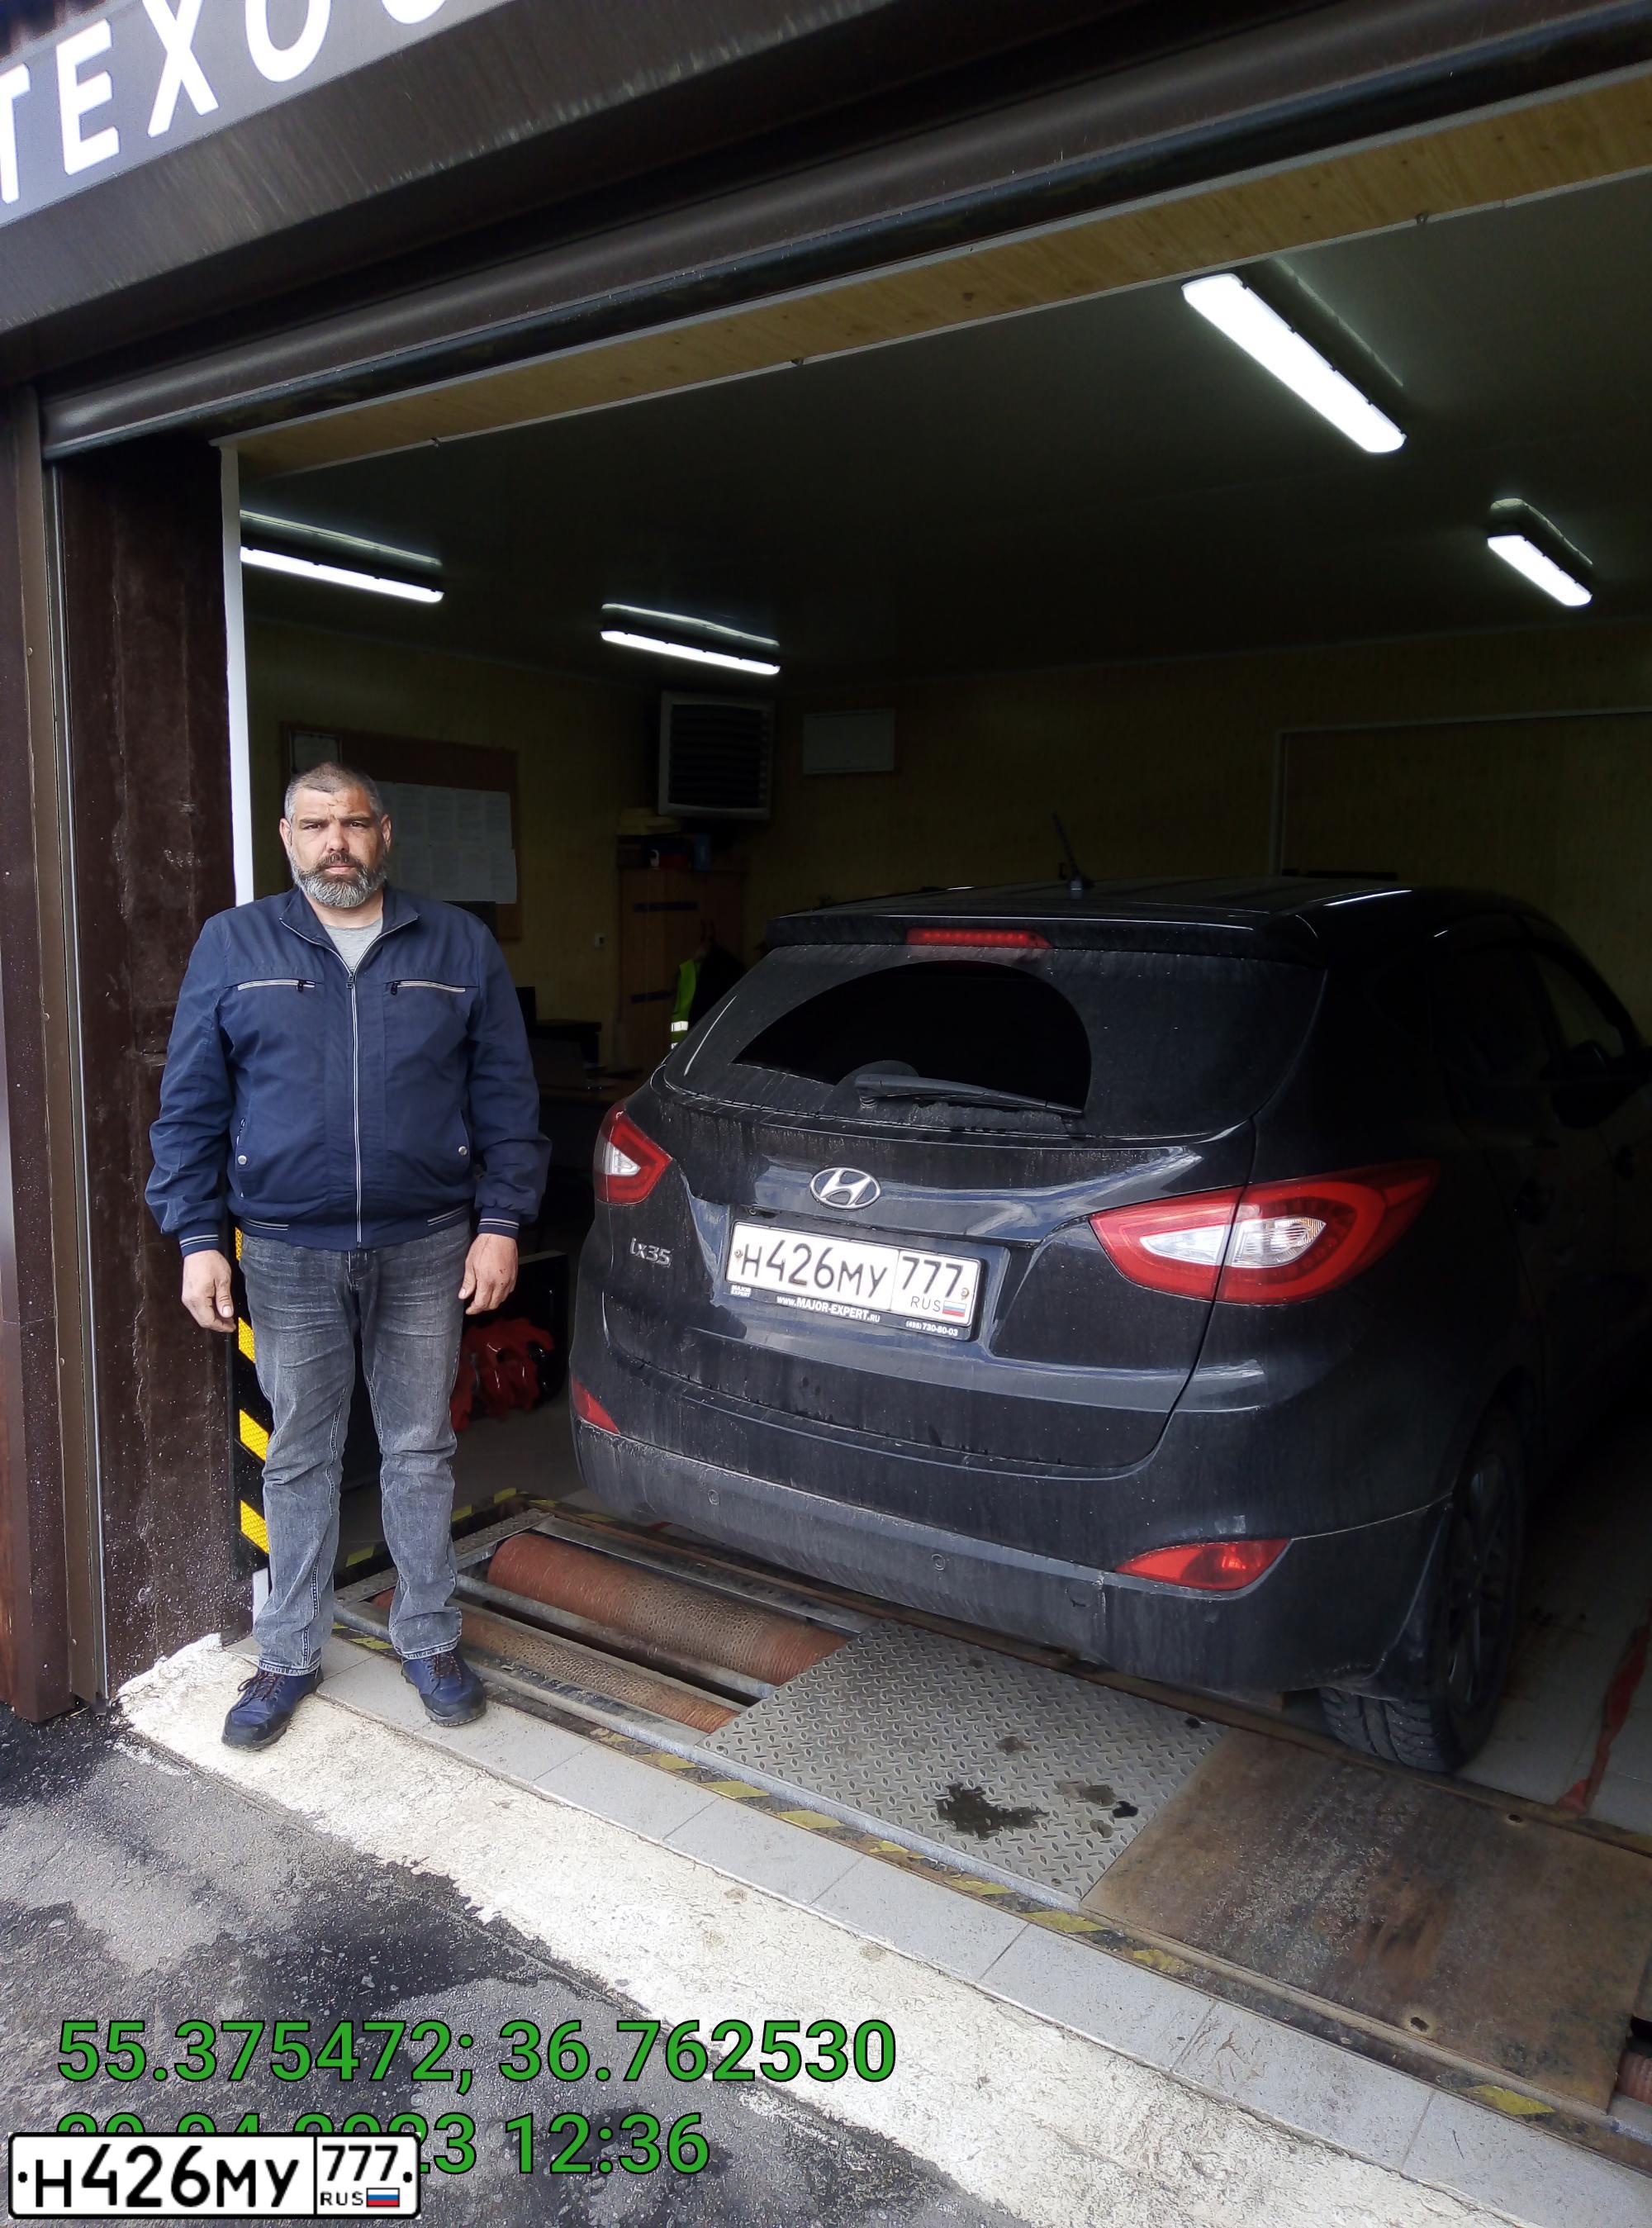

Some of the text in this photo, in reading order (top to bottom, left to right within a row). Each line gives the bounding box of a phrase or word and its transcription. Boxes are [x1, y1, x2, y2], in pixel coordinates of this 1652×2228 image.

[0, 0, 448, 204] ТЕХО
[630, 1238, 673, 1266] ix35
[902, 1256, 964, 1298] 777
[910, 1295, 942, 1313] RUS
